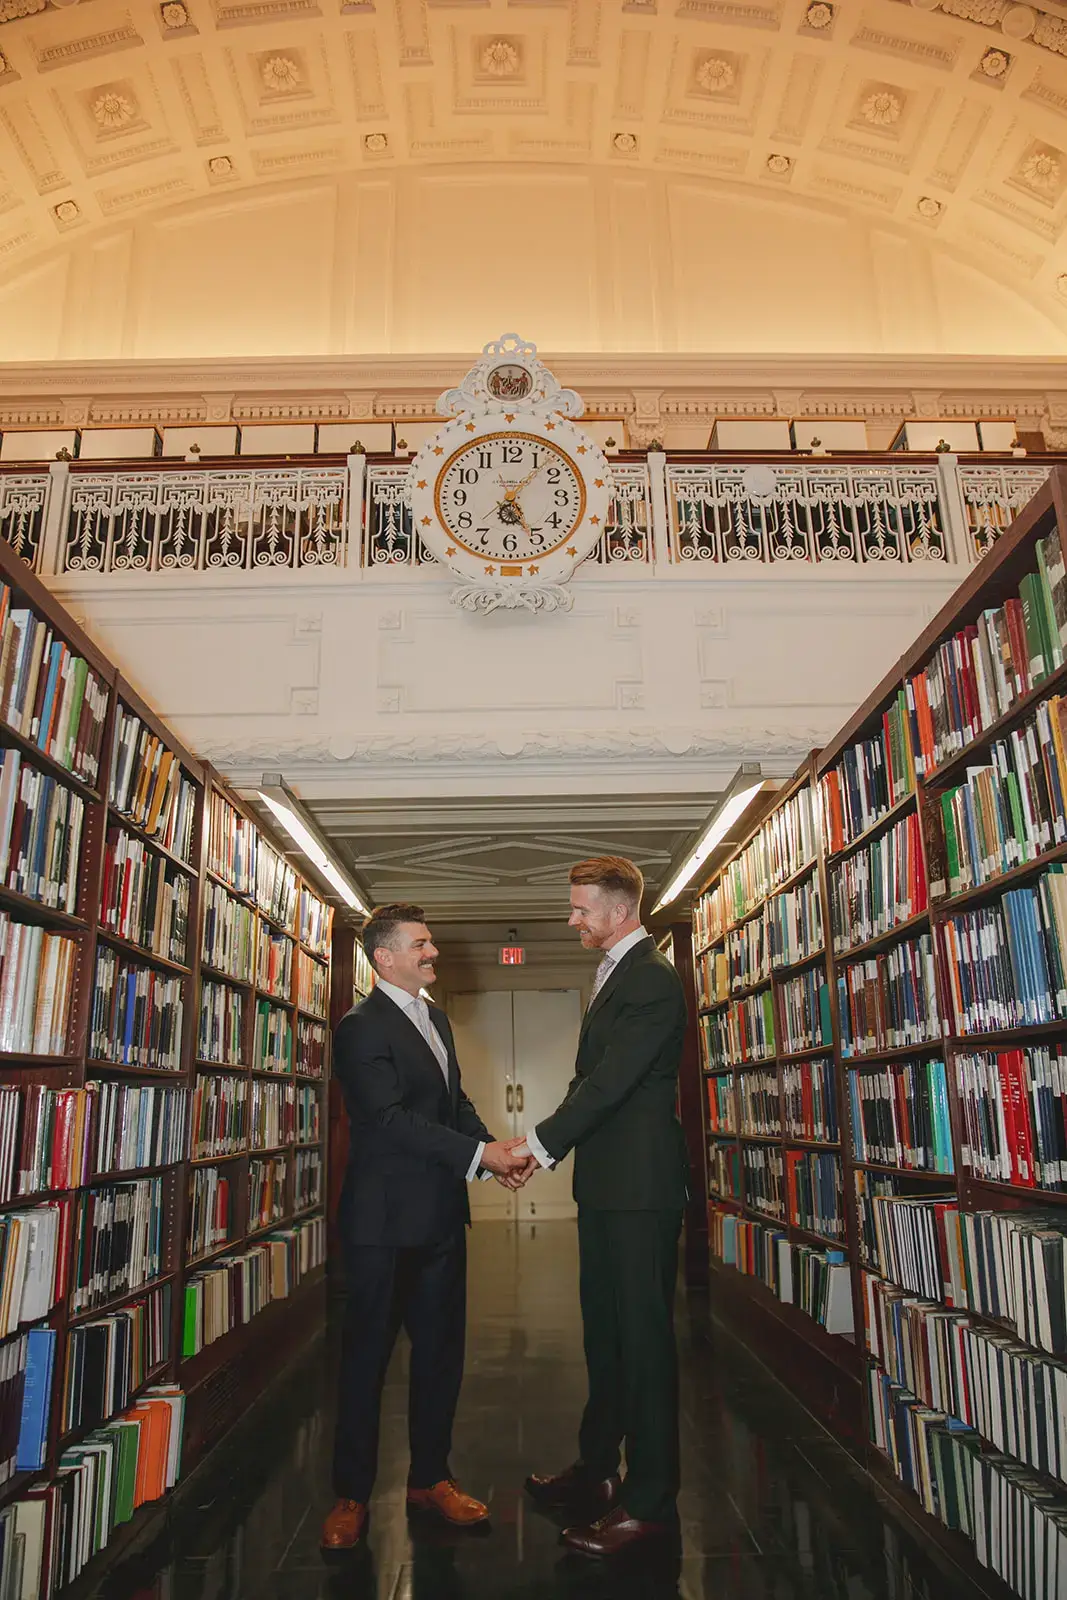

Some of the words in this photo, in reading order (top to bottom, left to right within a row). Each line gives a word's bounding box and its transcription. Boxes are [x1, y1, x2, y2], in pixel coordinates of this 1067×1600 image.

[478, 452, 492, 469] 11
[502, 446, 523, 463] 12
[532, 452, 538, 469] 1
[458, 468, 479, 484] 10
[547, 468, 561, 484] 2
[453, 489, 467, 506] 9
[554, 489, 569, 506] 3
[457, 511, 472, 529] 8
[544, 511, 562, 529] 4
[475, 528, 490, 545] 7
[502, 534, 517, 552] 6
[529, 527, 544, 545] 5
[502, 947, 522, 964] EXIT
